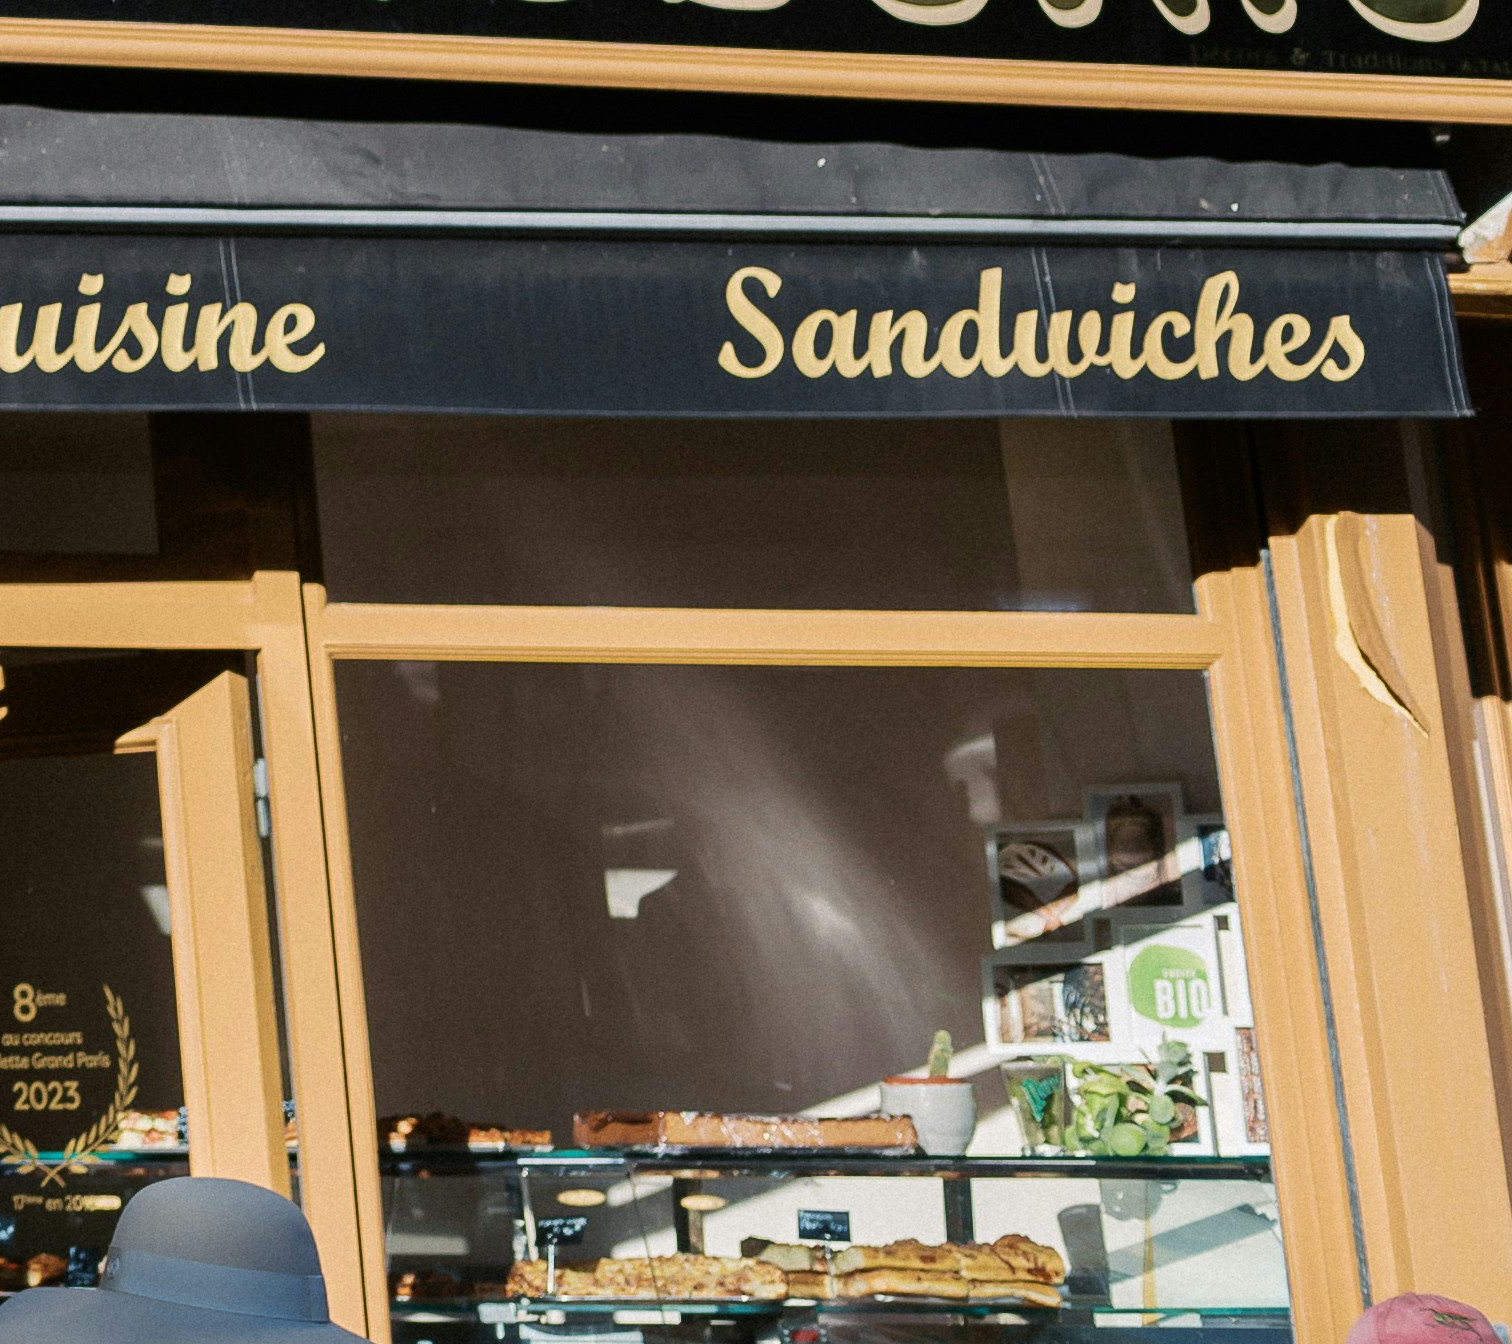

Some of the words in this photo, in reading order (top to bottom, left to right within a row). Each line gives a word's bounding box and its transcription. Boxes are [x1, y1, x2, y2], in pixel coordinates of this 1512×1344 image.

[716, 265, 1368, 384] Sandwiches
[1153, 978, 1212, 1020] BIO
[1, 1032, 20, 1047] au
[22, 1030, 84, 1047] concours
[31, 1052, 75, 1070] Grand
[76, 1050, 112, 1069] Paris
[12, 1080, 82, 1111] 2023
[45, 1197, 64, 1212] en
